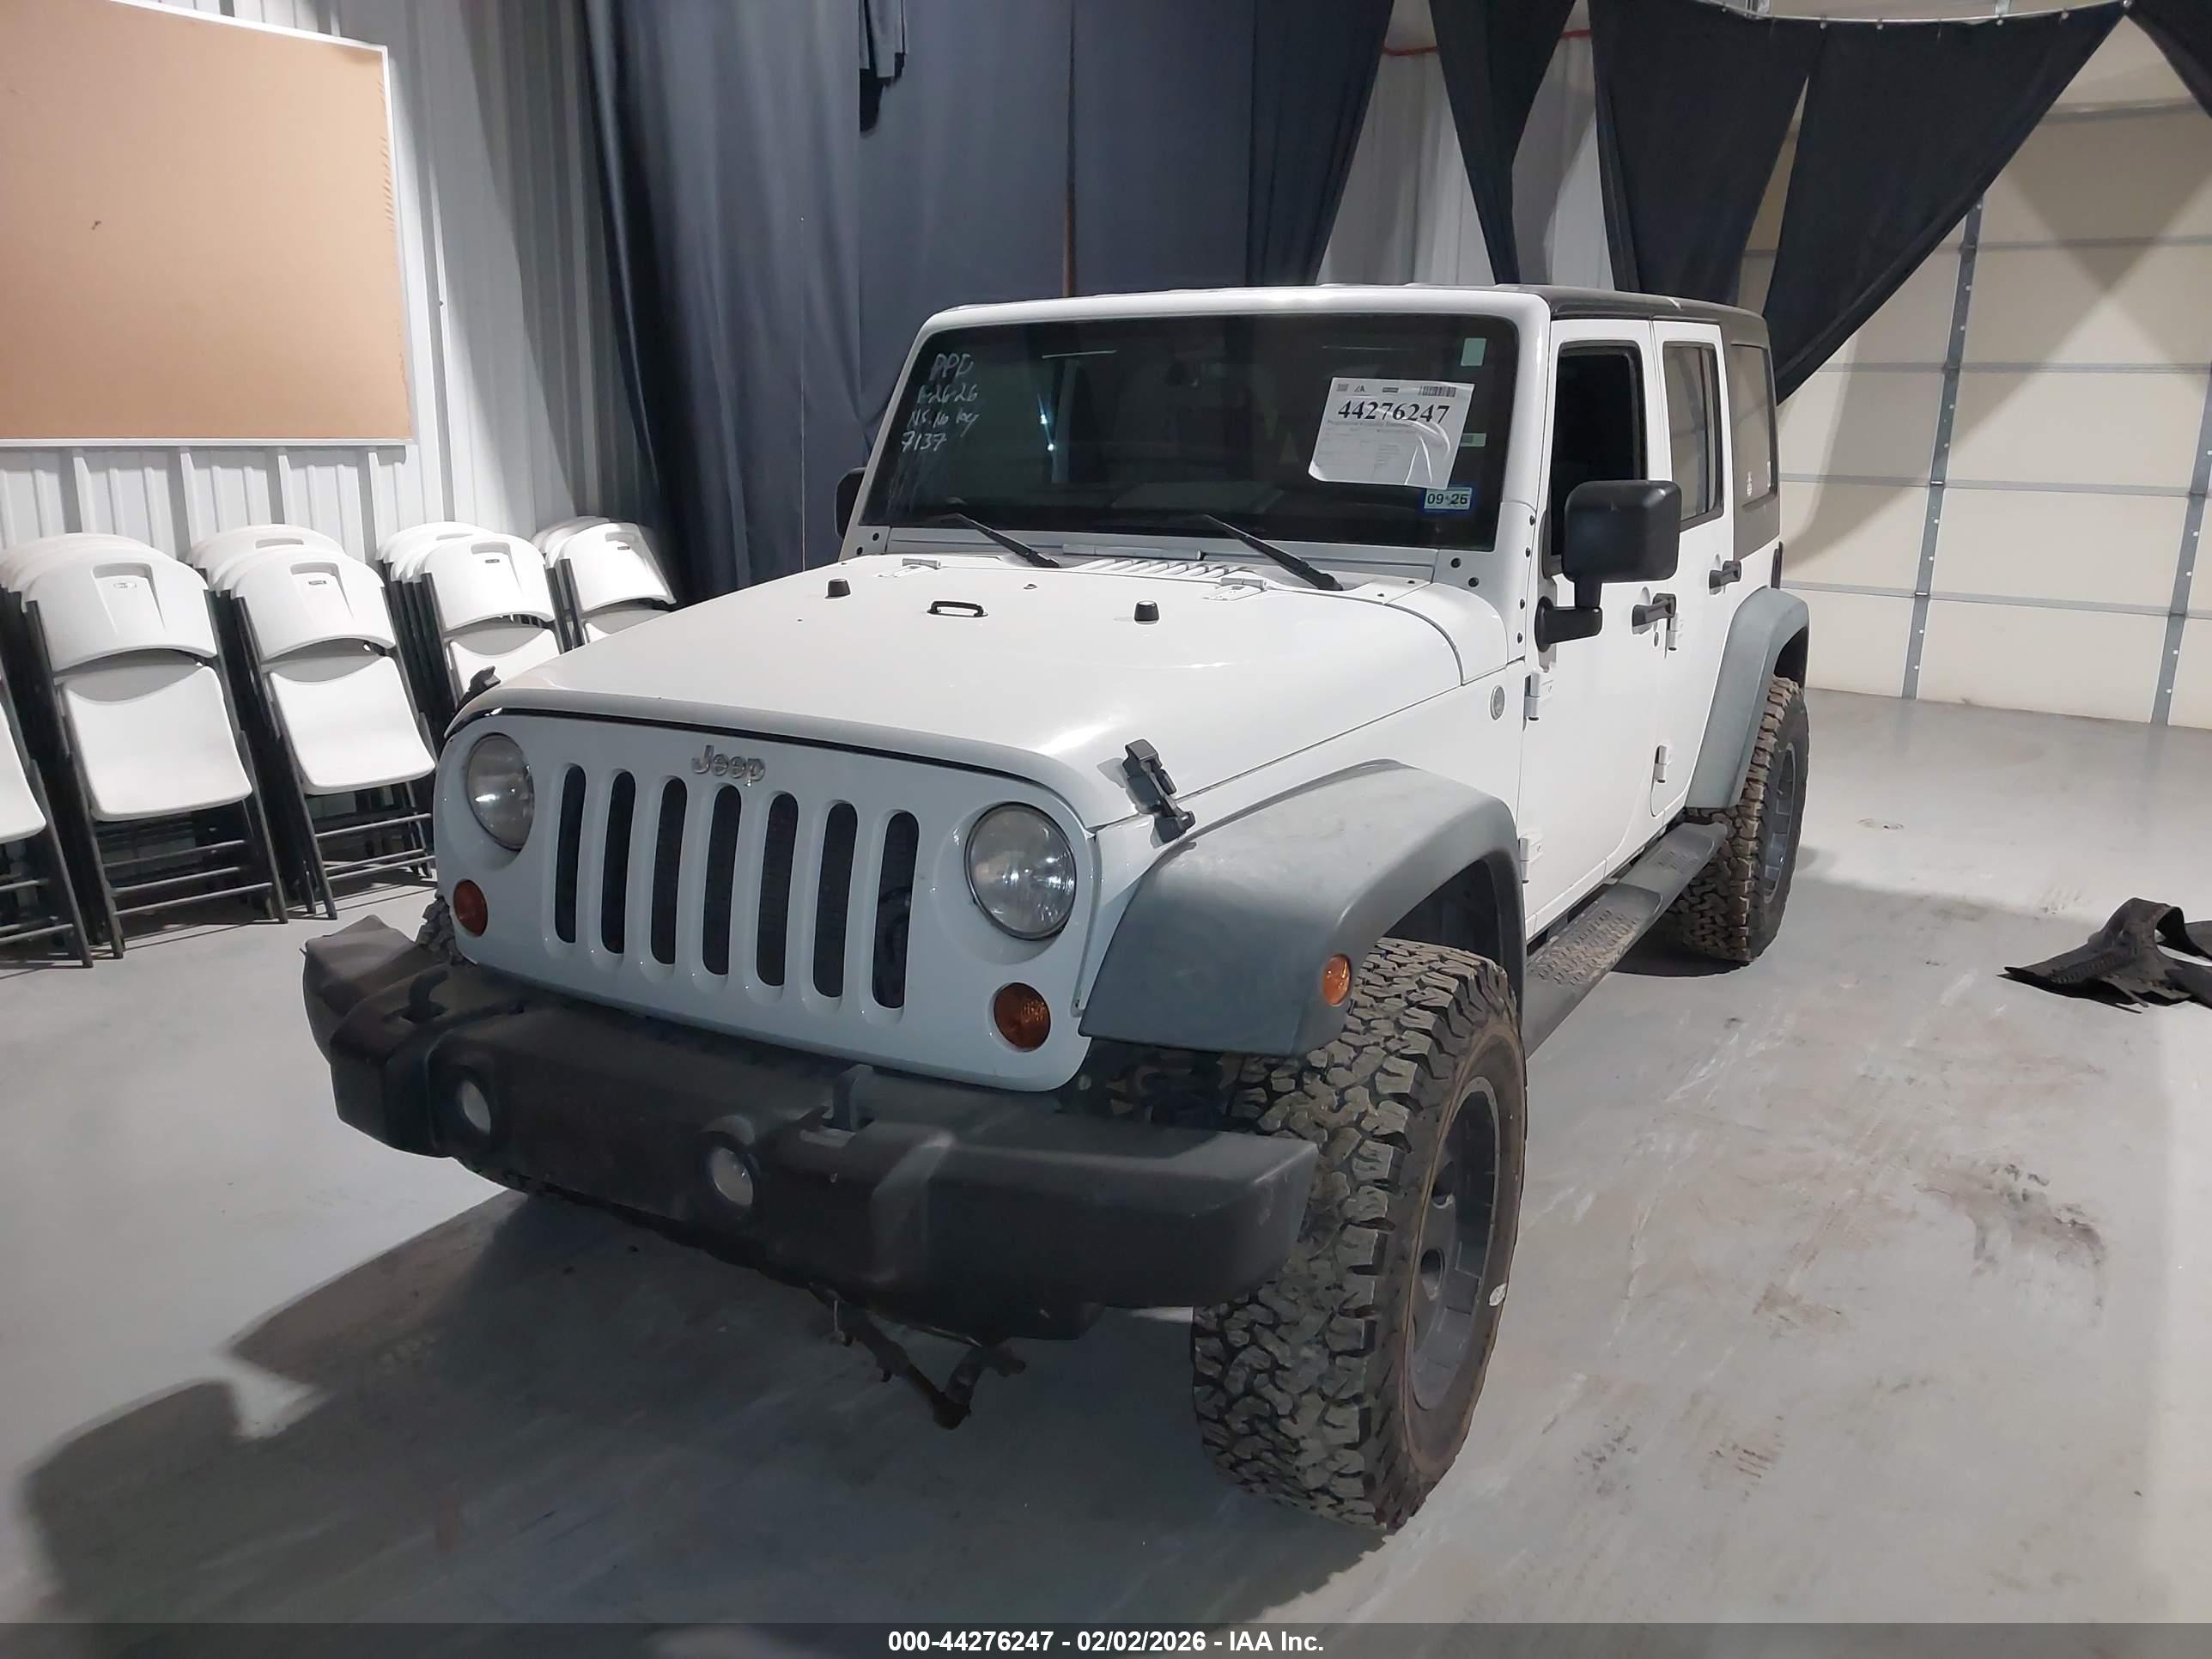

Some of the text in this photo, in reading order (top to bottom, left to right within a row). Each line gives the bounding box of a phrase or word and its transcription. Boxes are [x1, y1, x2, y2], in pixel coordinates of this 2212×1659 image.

[1337, 399, 1451, 424] 44276247
[901, 430, 948, 453] 7137
[691, 744, 766, 787] Jeep
